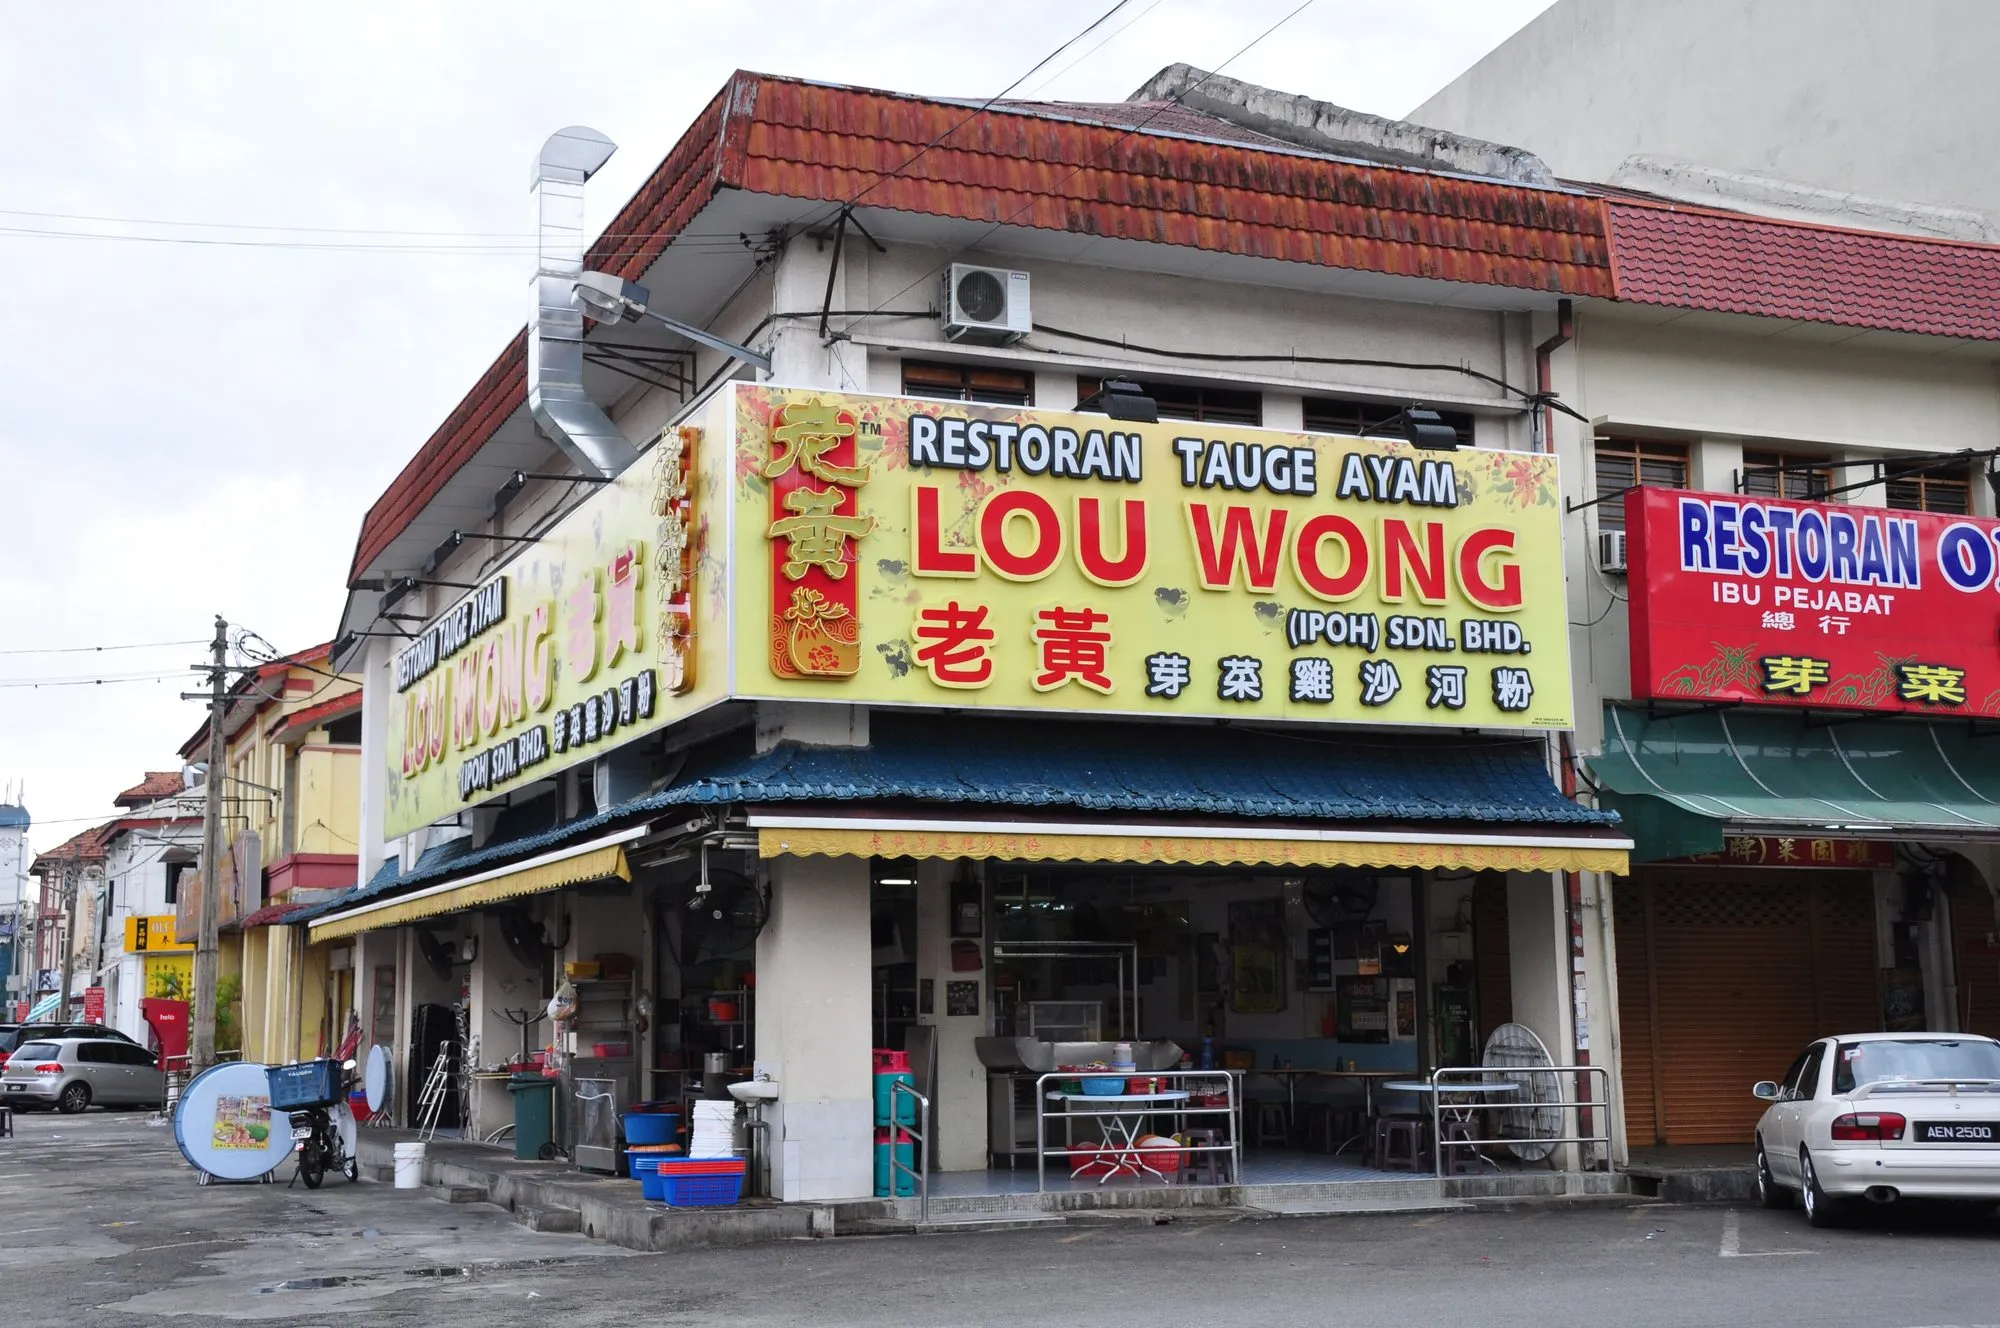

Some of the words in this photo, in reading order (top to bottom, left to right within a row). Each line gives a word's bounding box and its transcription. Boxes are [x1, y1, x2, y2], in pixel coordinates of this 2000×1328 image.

[860, 421, 881, 435] TM
[910, 415, 1142, 480] RESTORAN
[1176, 439, 1317, 494] TAUGE
[1339, 453, 1458, 506] AYAM
[914, 485, 1149, 583] LOU
[1188, 502, 1524, 608] WONG
[1679, 497, 1922, 590] RESTORAN
[1937, 522, 2000, 594] O
[398, 628, 439, 693] RESTORAN
[439, 602, 472, 661] TAUGE
[470, 576, 506, 637] AYAM
[1289, 610, 1380, 651] (IPOH)
[1389, 616, 1457, 649] SDN.
[1464, 621, 1532, 652] BHD.
[1713, 581, 1762, 606] IBU
[1774, 586, 1895, 616] PEJABAT
[916, 601, 1113, 690] 老黃
[1764, 656, 1966, 704] 芽菜
[403, 668, 449, 779] LOU
[454, 600, 556, 751] WONG
[460, 751, 491, 801] (IPOH)
[491, 738, 519, 784] SDN.
[518, 725, 550, 769] BHD.
[1844, 1049, 1861, 1060] P
[1927, 1127, 1954, 1138] AEN
[1955, 1127, 1992, 1139] 2500
